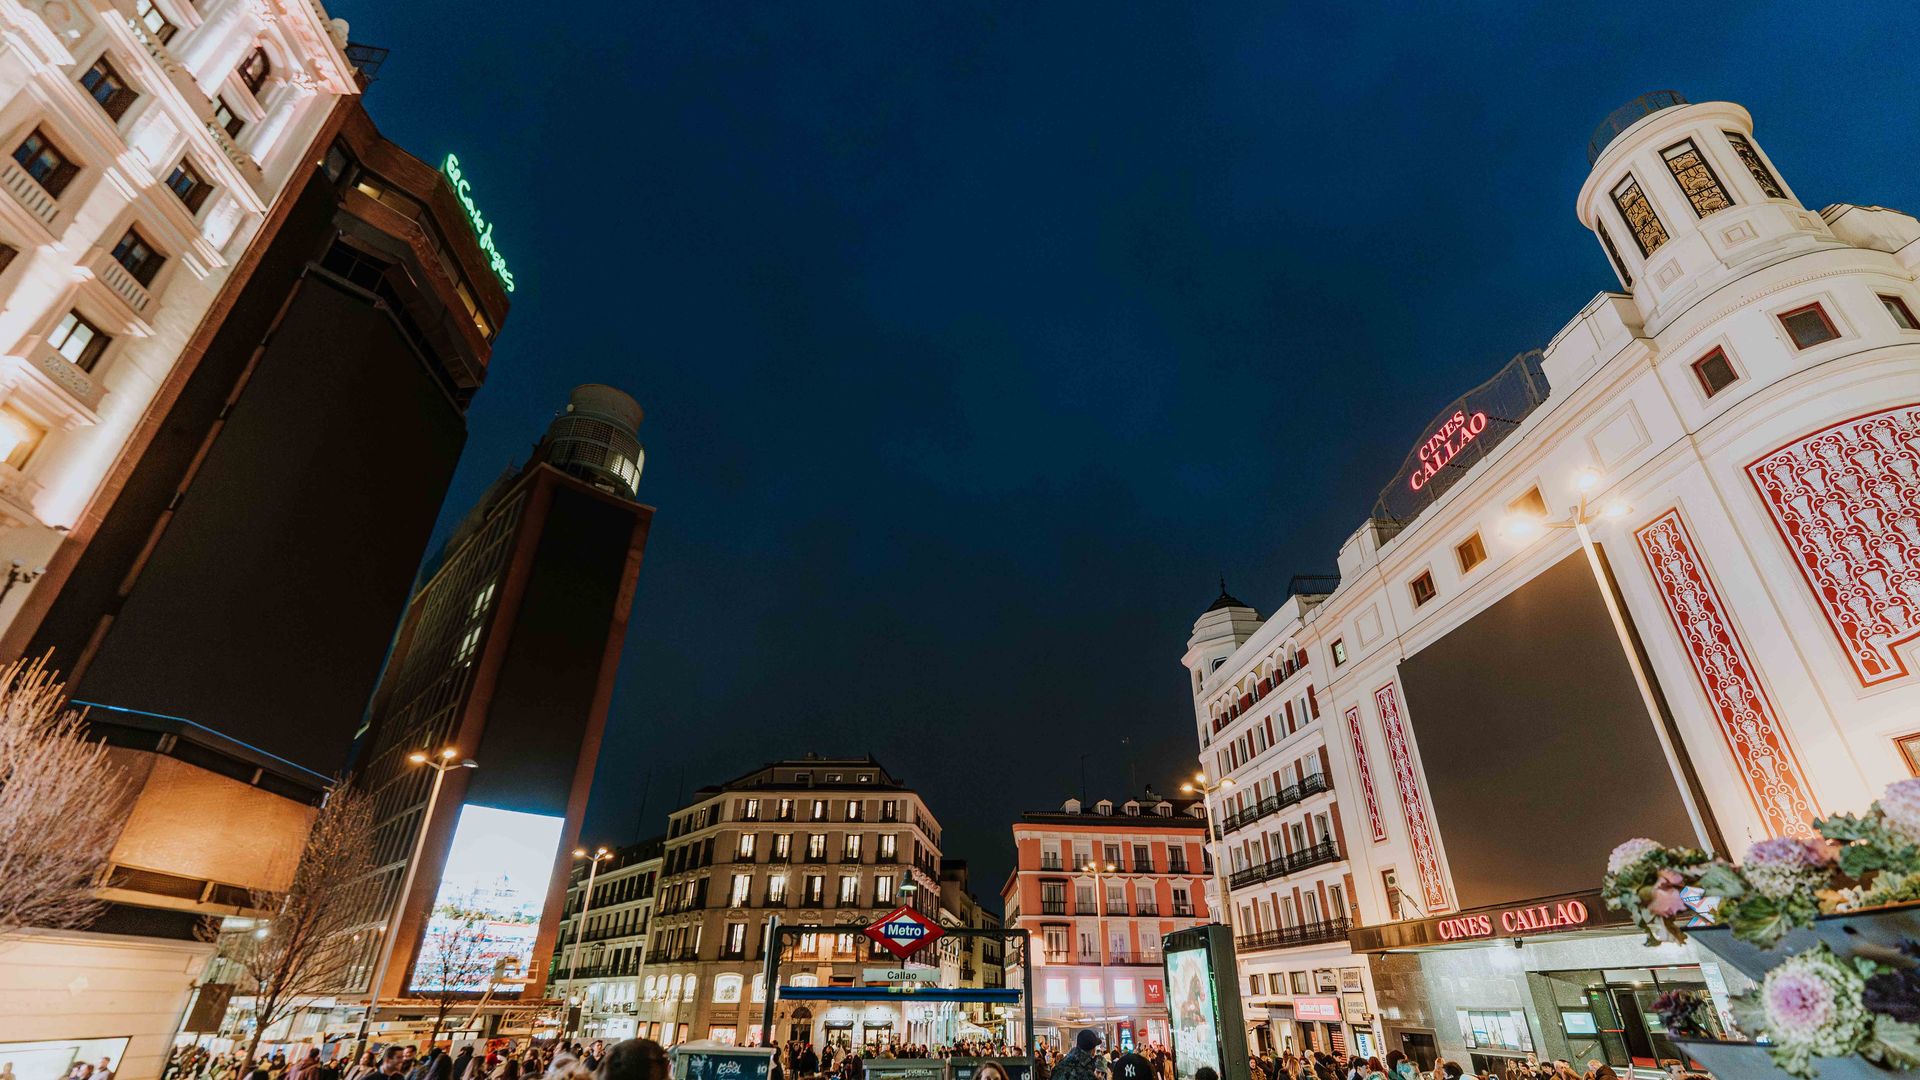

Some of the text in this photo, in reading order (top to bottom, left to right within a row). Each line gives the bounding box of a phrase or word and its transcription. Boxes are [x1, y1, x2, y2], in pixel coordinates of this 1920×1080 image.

[446, 153, 461, 186] El
[1410, 412, 1487, 490] CALLAO
[1419, 410, 1465, 461] CINES
[888, 924, 922, 937] Metro
[1438, 900, 1589, 940] CINES CALLAO
[887, 971, 917, 980] Callao
